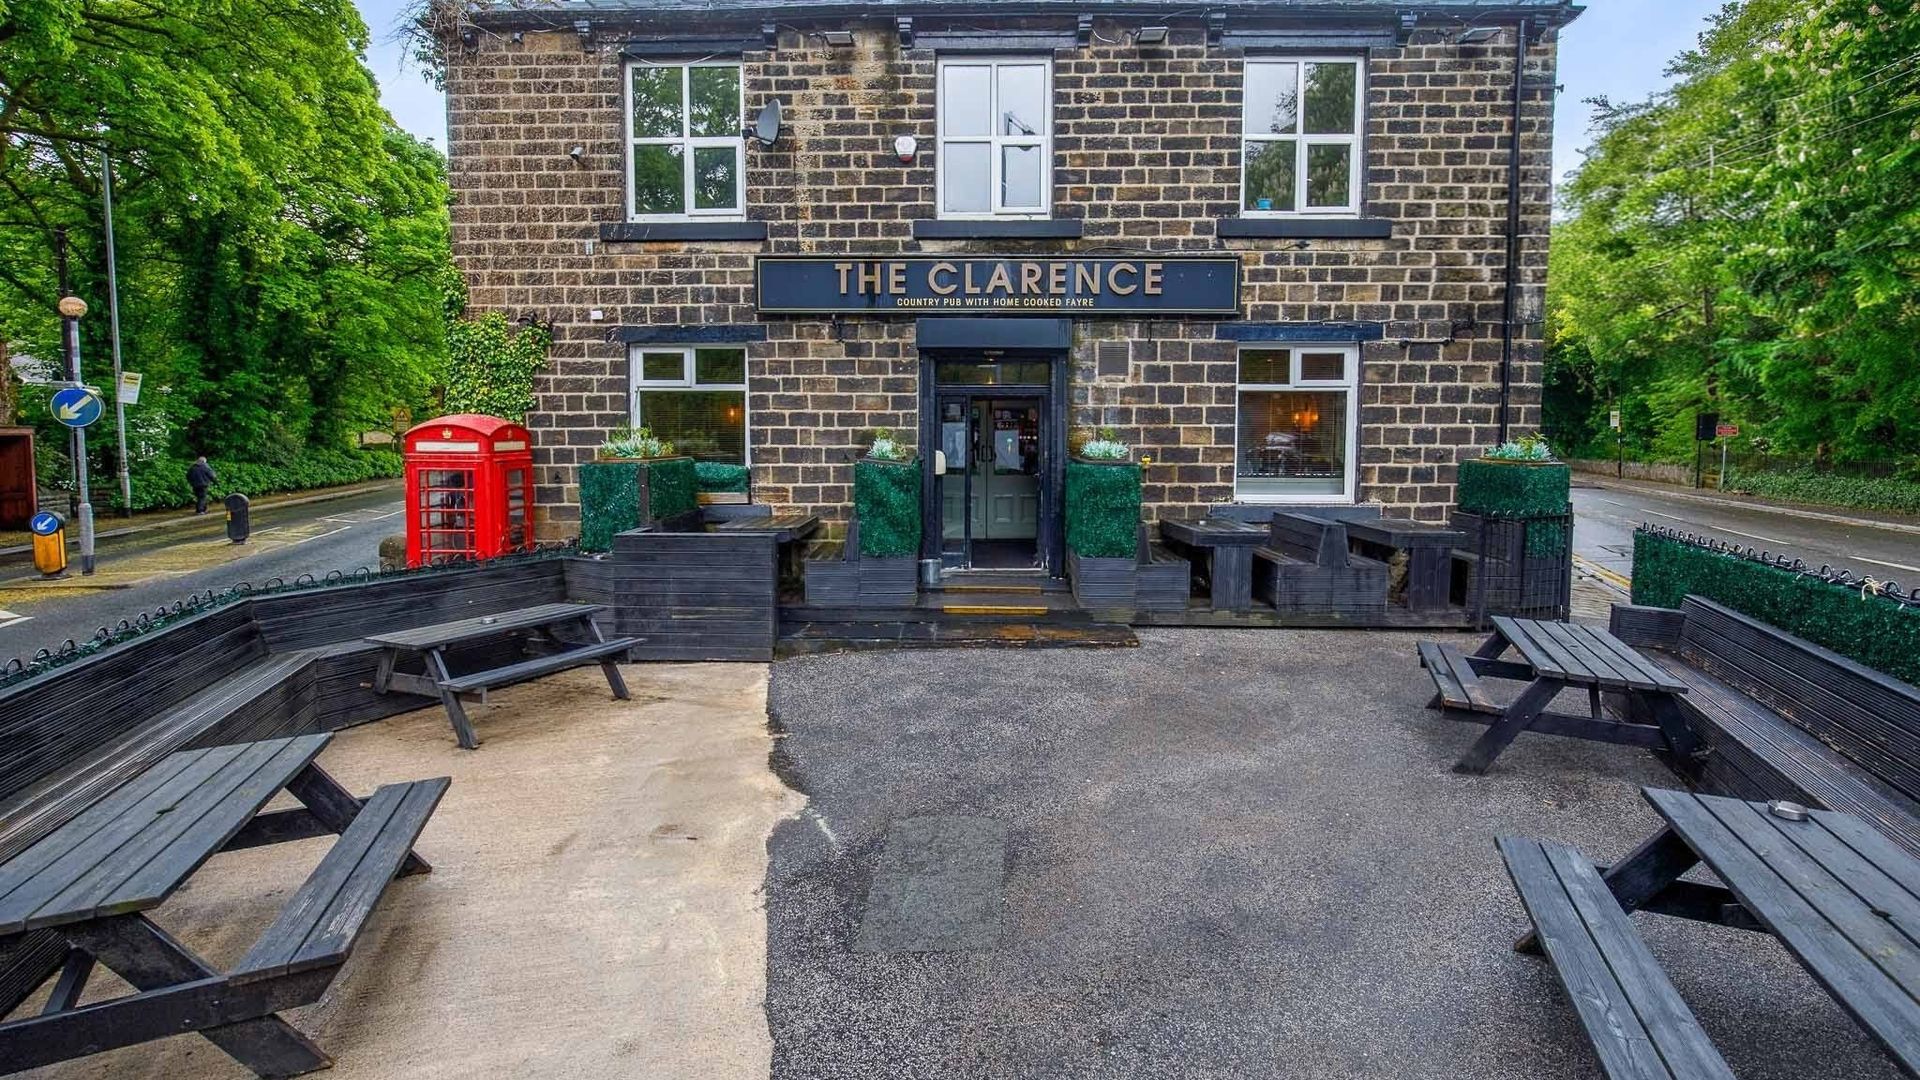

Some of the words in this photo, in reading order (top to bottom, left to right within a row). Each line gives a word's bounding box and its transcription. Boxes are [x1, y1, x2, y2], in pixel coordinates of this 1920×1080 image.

[835, 263, 906, 294] THE
[928, 262, 1163, 295] CLARENCE
[897, 298, 940, 306] COUNTRY
[943, 298, 962, 306] PUB
[966, 298, 989, 306] WITH
[993, 298, 1020, 306] HOME
[1023, 298, 1062, 306] COOKED
[1065, 298, 1094, 306] FAYRE
